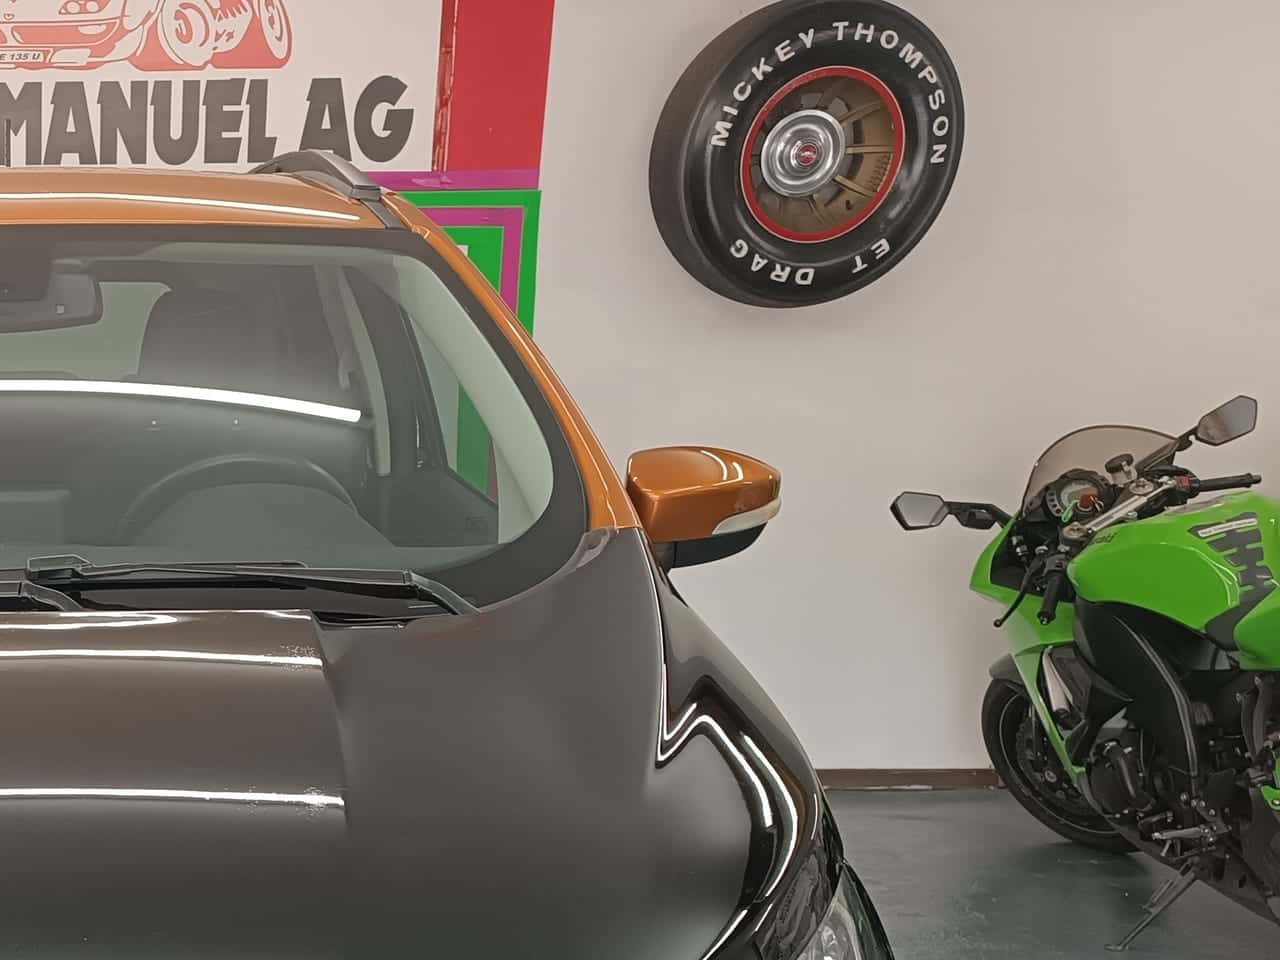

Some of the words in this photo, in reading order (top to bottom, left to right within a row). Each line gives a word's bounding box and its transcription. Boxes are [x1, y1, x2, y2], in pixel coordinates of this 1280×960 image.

[9, 53, 30, 61] 135
[710, 28, 816, 147] MICKEY
[832, 21, 949, 165] THOMPSON
[296, 75, 415, 163] AG
[729, 238, 815, 286] DRAG
[851, 238, 891, 274] ET
